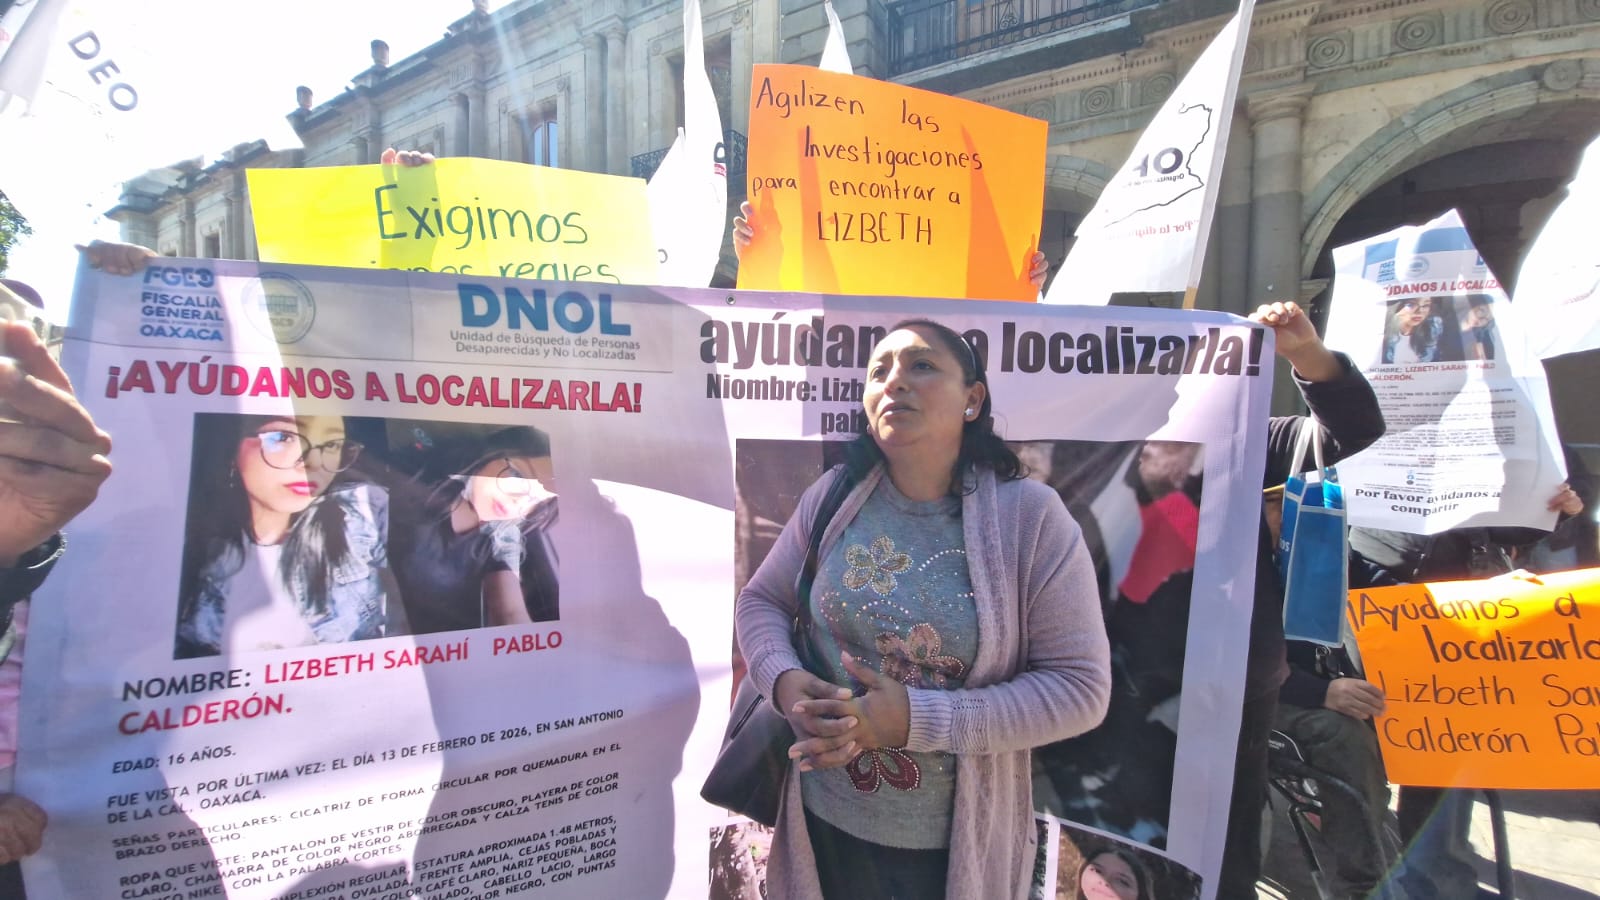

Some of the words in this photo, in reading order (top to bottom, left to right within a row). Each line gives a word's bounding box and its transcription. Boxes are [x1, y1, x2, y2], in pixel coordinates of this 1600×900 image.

[756, 77, 864, 119] Agilizen
[901, 99, 939, 133] las
[804, 125, 982, 178] Investigaciones
[752, 175, 797, 197] para
[829, 179, 935, 202] encontrar
[948, 191, 960, 205] a
[374, 183, 588, 250] Exigimos
[817, 211, 932, 245] LIZBETH
[141, 292, 222, 309] FISCALÍA
[1440, 281, 1447, 291] A
[141, 305, 224, 322] GENERAL
[457, 283, 632, 337] DNOL
[140, 324, 224, 341] OAXACA
[450, 331, 493, 342] Unidad
[496, 333, 511, 343] de
[514, 333, 571, 348] Búsqueda
[574, 335, 589, 347] de
[591, 338, 641, 350] Personas
[1001, 322, 1265, 376] localizarla!
[456, 341, 540, 357] Desaparecidas
[543, 347, 551, 358] y
[553, 347, 569, 357] No
[572, 348, 636, 360] Localizadas
[105, 355, 355, 400] ¡AYÚDANOS
[365, 371, 390, 402] A
[395, 373, 643, 413] LOCALIZARLA!
[706, 373, 817, 402] Niombre:
[822, 376, 865, 402] Lizb
[821, 409, 862, 435] pab
[1355, 488, 1380, 498] Por
[1384, 490, 1424, 503] favor
[1391, 502, 1459, 517] compartir
[1554, 592, 1581, 619] a
[122, 669, 251, 702] NOMBRE:
[264, 653, 374, 684] LIZBETH
[383, 637, 470, 670] SARAHÍ
[493, 631, 563, 656] PABLO
[1378, 671, 1516, 706] Lizbeth
[118, 692, 293, 736] CALDERÓN.
[1384, 716, 1530, 753] Calderón
[107, 793, 139, 808] FUE
[145, 787, 190, 801] VISTA
[197, 779, 228, 794] POR
[234, 770, 290, 787] ÚLTIMA
[296, 763, 326, 776] VEZ:
[332, 759, 348, 770] EL
[353, 752, 375, 767] DÍA
[382, 750, 396, 761] 13
[401, 746, 417, 758] DE
[422, 735, 477, 754] FEBRERO
[481, 732, 495, 744] DE
[536, 723, 550, 734] EN
[554, 718, 575, 730] SAN
[578, 709, 624, 726] ANTONIO
[112, 757, 160, 774] EDAD:
[168, 754, 185, 766] 16
[190, 745, 236, 763] AÑOS.
[108, 812, 128, 824] DE
[134, 808, 153, 821] LA
[200, 790, 267, 809] OAXACA.
[112, 834, 161, 848] SEÑAS
[167, 815, 282, 840] PARTICULARES:
[290, 801, 351, 819] CICATRIZ
[358, 796, 374, 807] DE
[381, 787, 425, 802] FORMA
[431, 773, 489, 791] CIRCULAR
[494, 767, 518, 779] POR
[522, 751, 588, 773] QUEMADURA
[593, 746, 606, 756] EN
[610, 743, 622, 752] EL
[120, 871, 162, 887] ROPA
[165, 863, 197, 878] QUE
[201, 854, 246, 870] VISTE:
[251, 838, 326, 860] PANTALON
[330, 833, 347, 844] DE
[351, 824, 394, 839] VESTIR
[398, 820, 413, 829] DE
[417, 811, 458, 825] COLOR
[521, 785, 568, 804] PLAYERA
[571, 781, 583, 791] DE
[586, 772, 619, 786] COLOR
[185, 863, 265, 887] CHAMARRA
[272, 857, 289, 868] DE
[296, 846, 342, 862] COLOR
[348, 835, 391, 851] NEGRO
[397, 817, 477, 840] ABORREGADA
[483, 814, 490, 822] Y
[495, 806, 530, 820] CALZA
[535, 796, 564, 811] TENIS
[568, 791, 581, 801] DE
[585, 782, 619, 796] COLOR
[116, 844, 167, 860] BRAZO
[415, 849, 475, 871] ESTATURA
[477, 832, 547, 855] APROXIMADA
[550, 825, 572, 837] 1.48
[420, 863, 464, 881] FRENTE
[519, 841, 551, 856] CEJAS
[555, 828, 606, 848] POBLADAS
[611, 826, 617, 834] Y
[232, 876, 262, 890] CON
[267, 872, 284, 882] LA
[289, 857, 350, 876] PALABRA
[426, 878, 456, 893] CAFÉ
[502, 857, 534, 873] NARIZ
[590, 838, 617, 851] BOCA
[483, 870, 532, 889] CABELLO
[584, 848, 616, 864] LARGO
[551, 870, 573, 883] CON
[577, 859, 616, 876] PUNTAS
